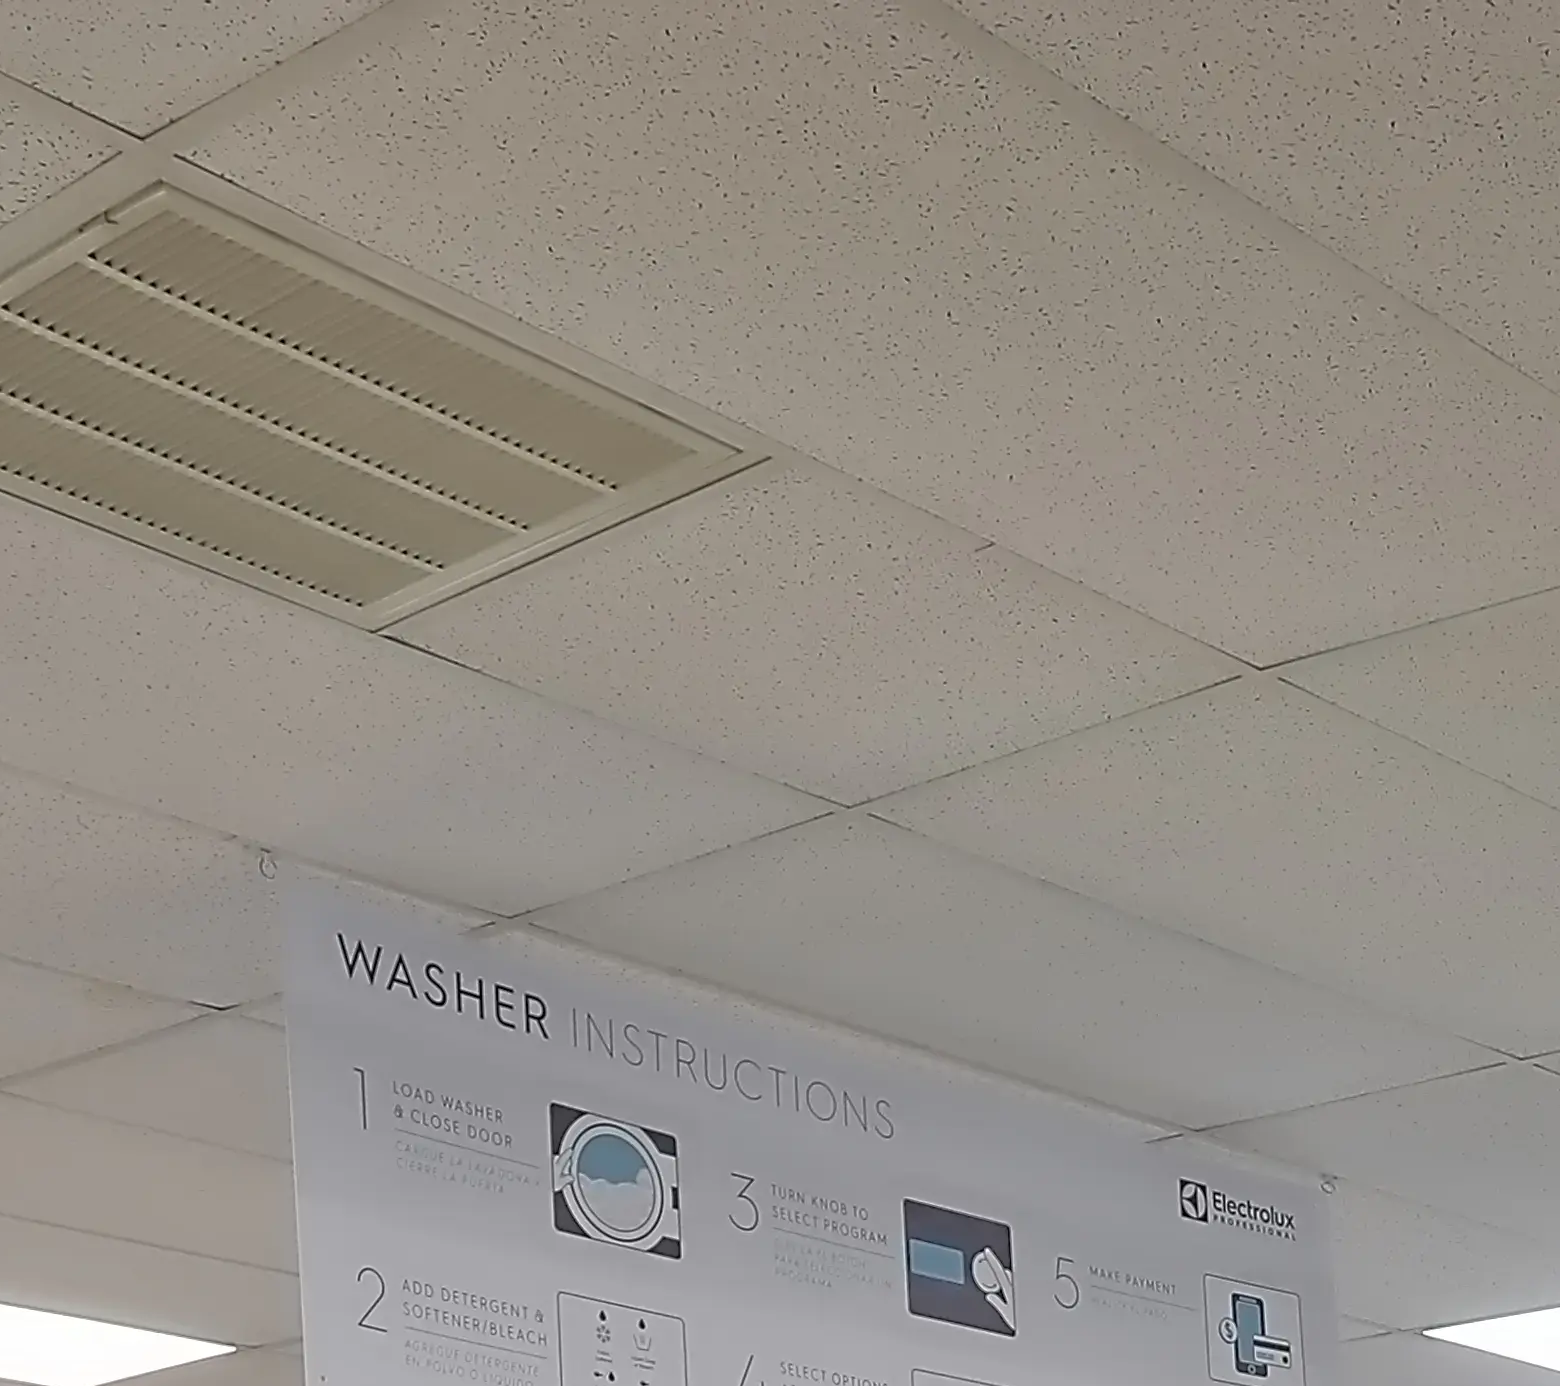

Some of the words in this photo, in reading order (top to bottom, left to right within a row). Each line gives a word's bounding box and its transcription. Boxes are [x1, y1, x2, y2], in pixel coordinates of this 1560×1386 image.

[337, 932, 549, 1040] WASHER
[571, 1007, 895, 1139] INSTRUCTIONS
[353, 1066, 368, 1130] 1
[392, 1080, 435, 1104] LOAD
[440, 1094, 504, 1124] WASHER
[393, 1103, 404, 1119] &
[410, 1108, 460, 1135] CLOSE
[466, 1123, 513, 1149] DOOR
[728, 1172, 760, 1232] 3
[770, 1183, 806, 1205] TURN
[810, 1195, 848, 1216] KNOB
[852, 1205, 870, 1221] TO
[1212, 1190, 1297, 1230] Electrolux
[771, 1205, 819, 1229] SELECT
[823, 1217, 889, 1246] PROGRAM
[1212, 1213, 1298, 1242] PROFESSIONAL
[357, 1266, 388, 1333] 2
[402, 1278, 435, 1298] ADD
[440, 1286, 529, 1320] DETERGENT
[534, 1309, 545, 1324] &
[1053, 1256, 1081, 1309] 5
[1089, 1265, 1122, 1284] MAKE
[1125, 1273, 1178, 1297] PAYMENT
[402, 1301, 548, 1347] SOFTENER/BLEACH
[779, 1360, 828, 1383] SELECT
